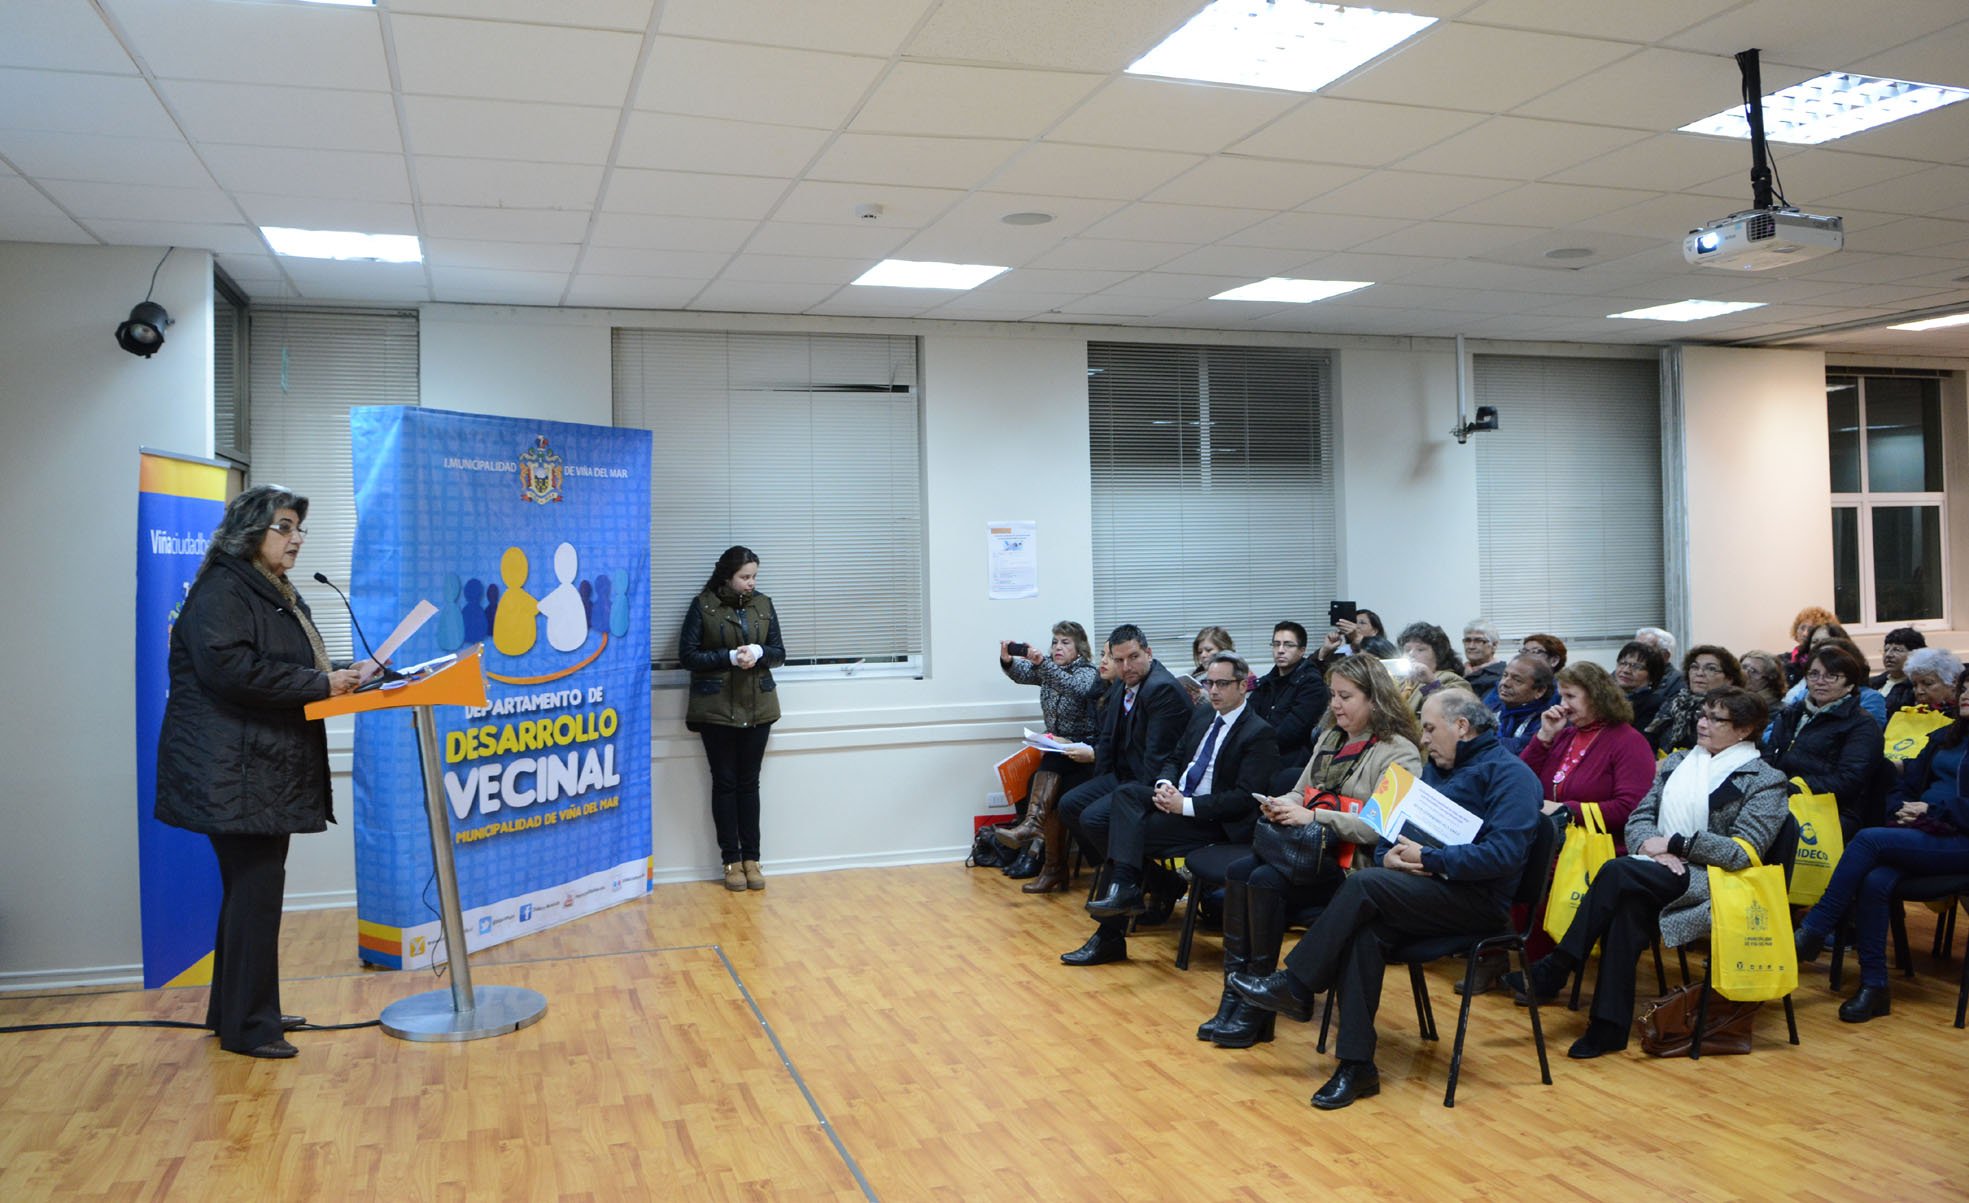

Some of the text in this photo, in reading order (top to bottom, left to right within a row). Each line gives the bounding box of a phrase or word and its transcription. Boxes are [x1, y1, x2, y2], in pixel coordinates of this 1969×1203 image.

[564, 466, 576, 476] DE
[576, 465, 593, 477] VIÑA
[594, 468, 609, 478] DEL
[610, 469, 628, 478] MAR
[588, 687, 604, 704] DE
[446, 707, 617, 763] DESARROLLO
[444, 744, 621, 820] VECINAL
[456, 796, 620, 843] MUNICIPALIDAD DE VIÑA DEL MAR
